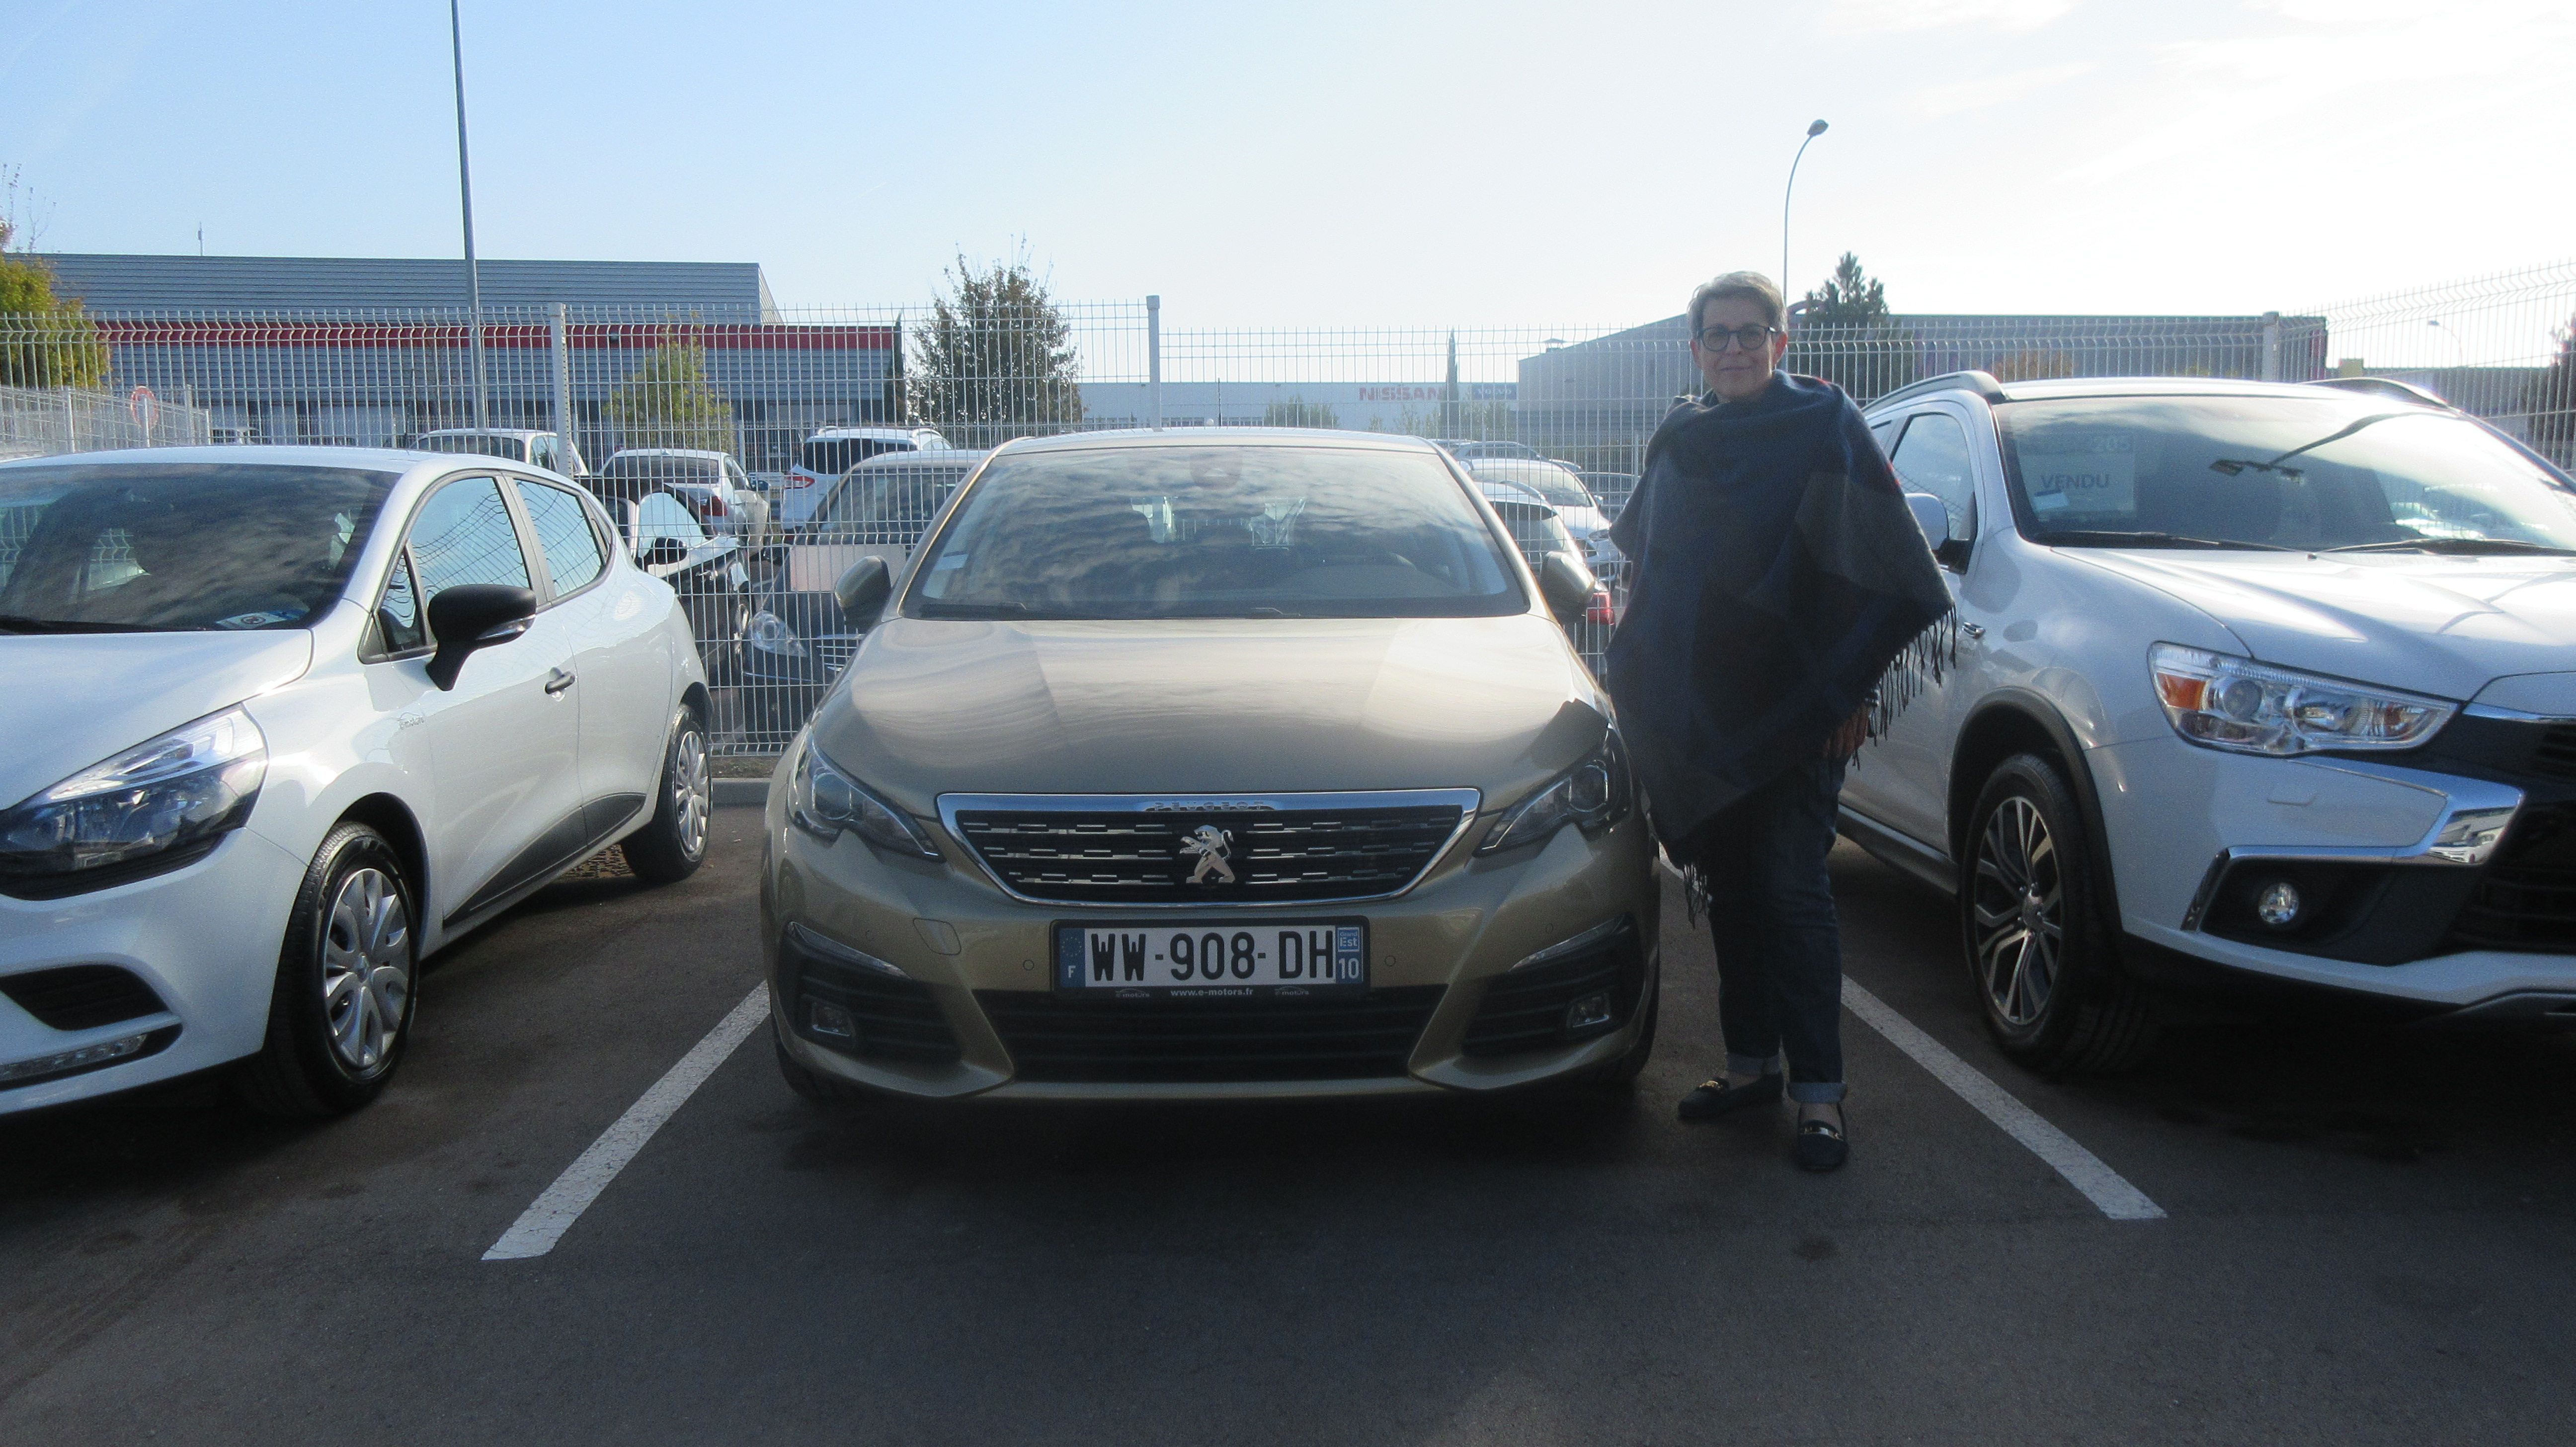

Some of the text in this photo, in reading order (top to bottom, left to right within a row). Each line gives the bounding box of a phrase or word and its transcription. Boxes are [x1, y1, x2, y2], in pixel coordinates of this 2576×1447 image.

[1359, 387, 1444, 401] NISSAN
[2040, 474, 2110, 489] VENDU
[1154, 801, 1264, 811] PEUGEOT
[1340, 937, 1358, 947] Est
[1068, 965, 1076, 978] F
[1338, 958, 1359, 979] 10
[1170, 987, 1254, 996] www.e-motors.fr
